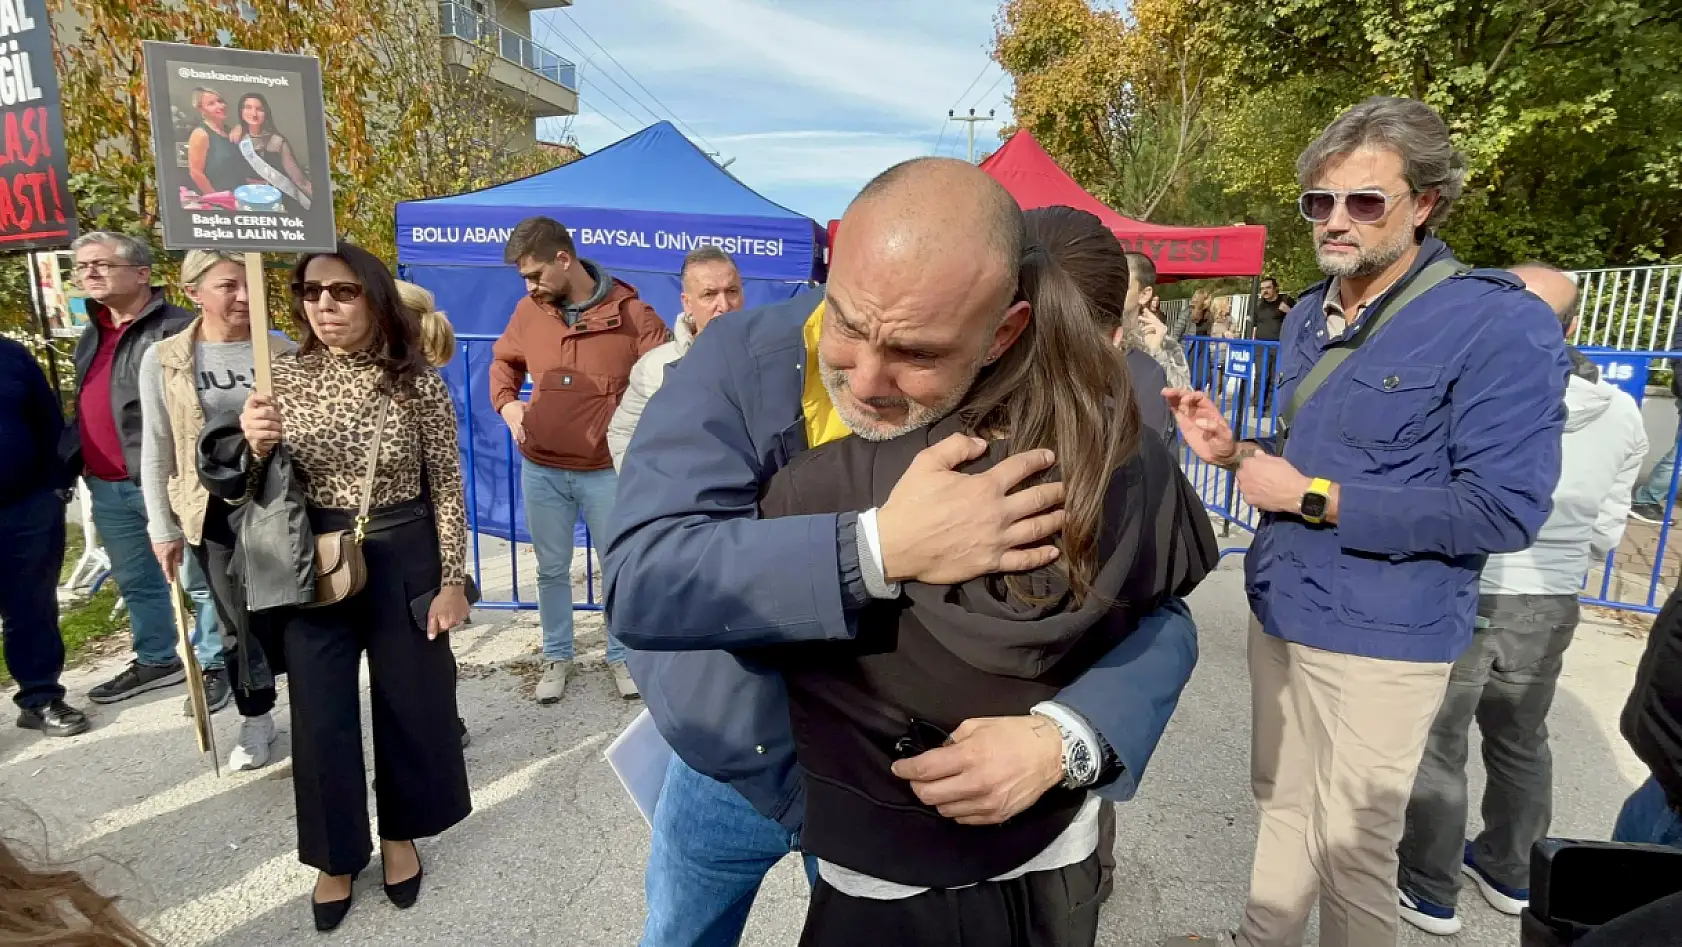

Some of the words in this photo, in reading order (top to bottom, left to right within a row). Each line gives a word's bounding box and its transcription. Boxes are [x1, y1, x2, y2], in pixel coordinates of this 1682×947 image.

[0, 0, 35, 36] AL
[0, 39, 43, 107] ĞİL
[178, 67, 289, 87] @baskacanimizyok
[191, 213, 232, 226] Başka
[234, 215, 278, 226] CEREN
[280, 217, 304, 228] Yok
[193, 227, 234, 240] Başka
[237, 227, 278, 240] LALİN
[280, 230, 305, 240] Yok
[412, 227, 459, 243] BOLU
[463, 227, 515, 243] ABAN
[581, 228, 650, 248] BAYSAL
[655, 230, 783, 257] ÜNİVERSİTESİ
